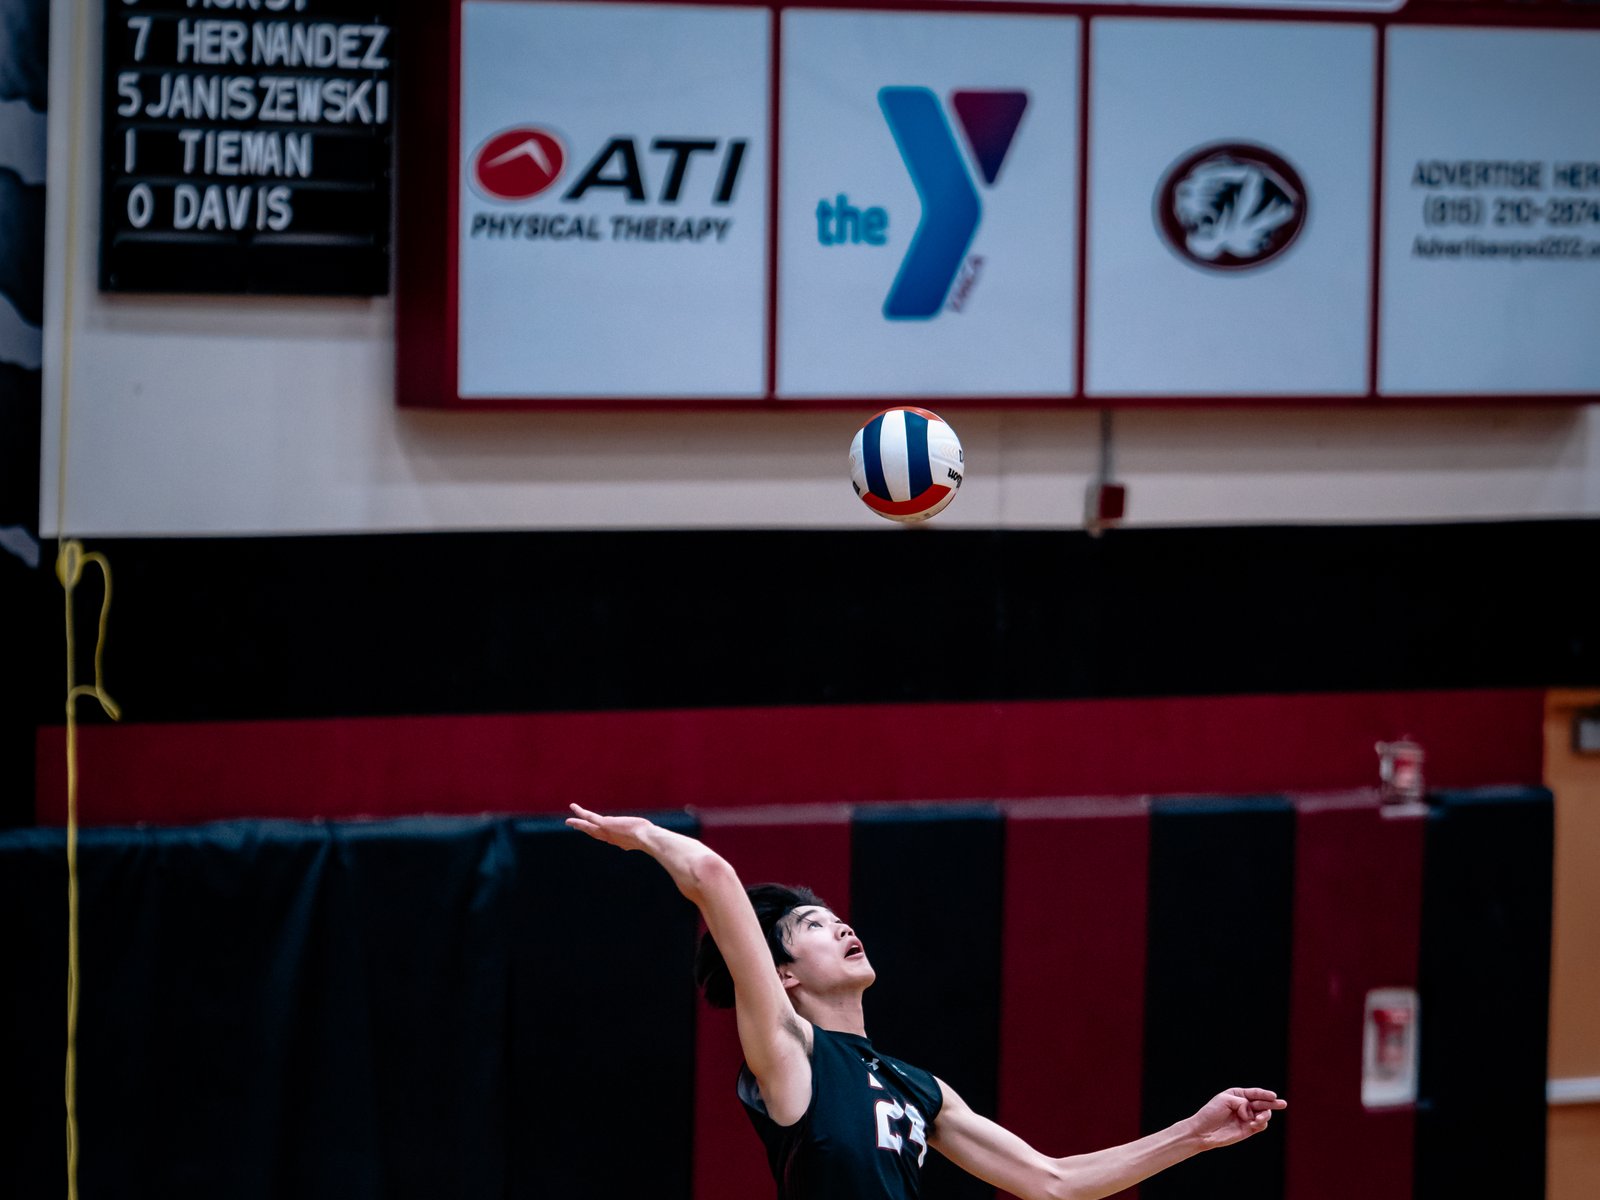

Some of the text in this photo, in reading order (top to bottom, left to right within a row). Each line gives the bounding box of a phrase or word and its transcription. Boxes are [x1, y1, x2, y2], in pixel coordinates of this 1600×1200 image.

[128, 17, 389, 69] 7 HERNANDEZ
[117, 72, 389, 124] 5 JANISZEWSKI
[125, 128, 312, 178] 1 TIEMAN
[561, 137, 748, 203] ATI
[1412, 160, 1543, 188] ADVERTISE
[127, 183, 293, 231] 0 DAVIS
[471, 213, 731, 243] PHYSICAL THERAPY
[816, 193, 888, 246] the
